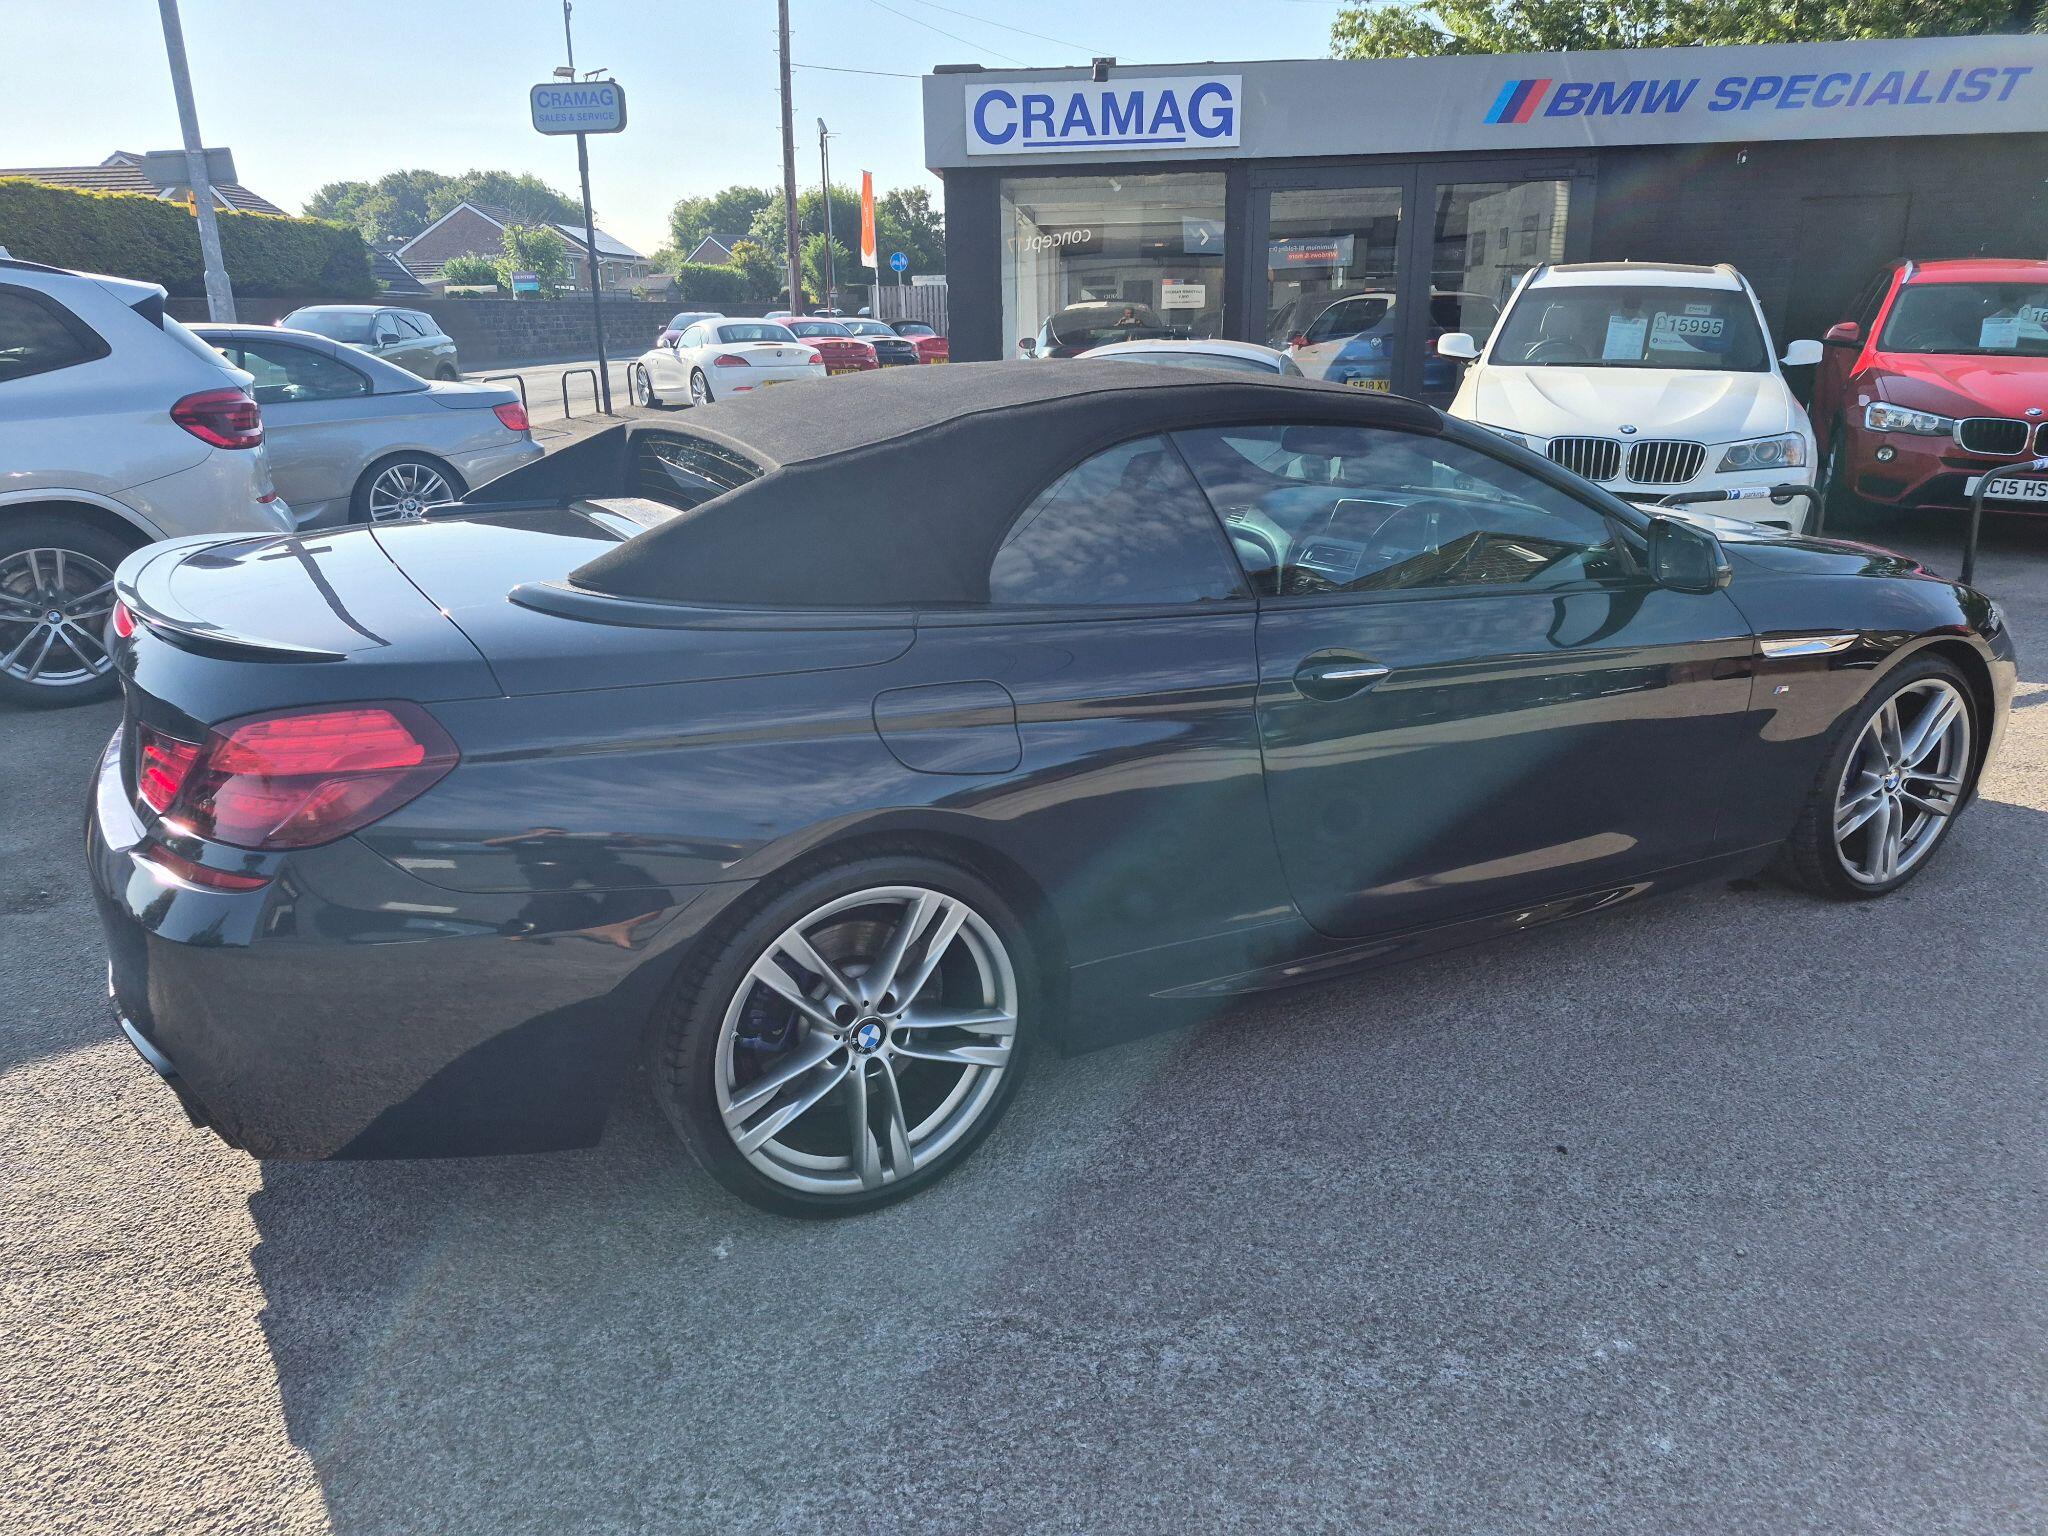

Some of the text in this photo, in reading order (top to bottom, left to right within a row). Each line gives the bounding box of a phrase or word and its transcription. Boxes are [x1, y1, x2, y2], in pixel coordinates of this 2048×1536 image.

[537, 88, 614, 108] CRAMAG
[1543, 66, 2035, 117] BMW SPECIALIST
[538, 111, 615, 122] SALES & SERVICE
[973, 82, 1233, 145] CRAMAG
[1989, 480, 2018, 494] C15
